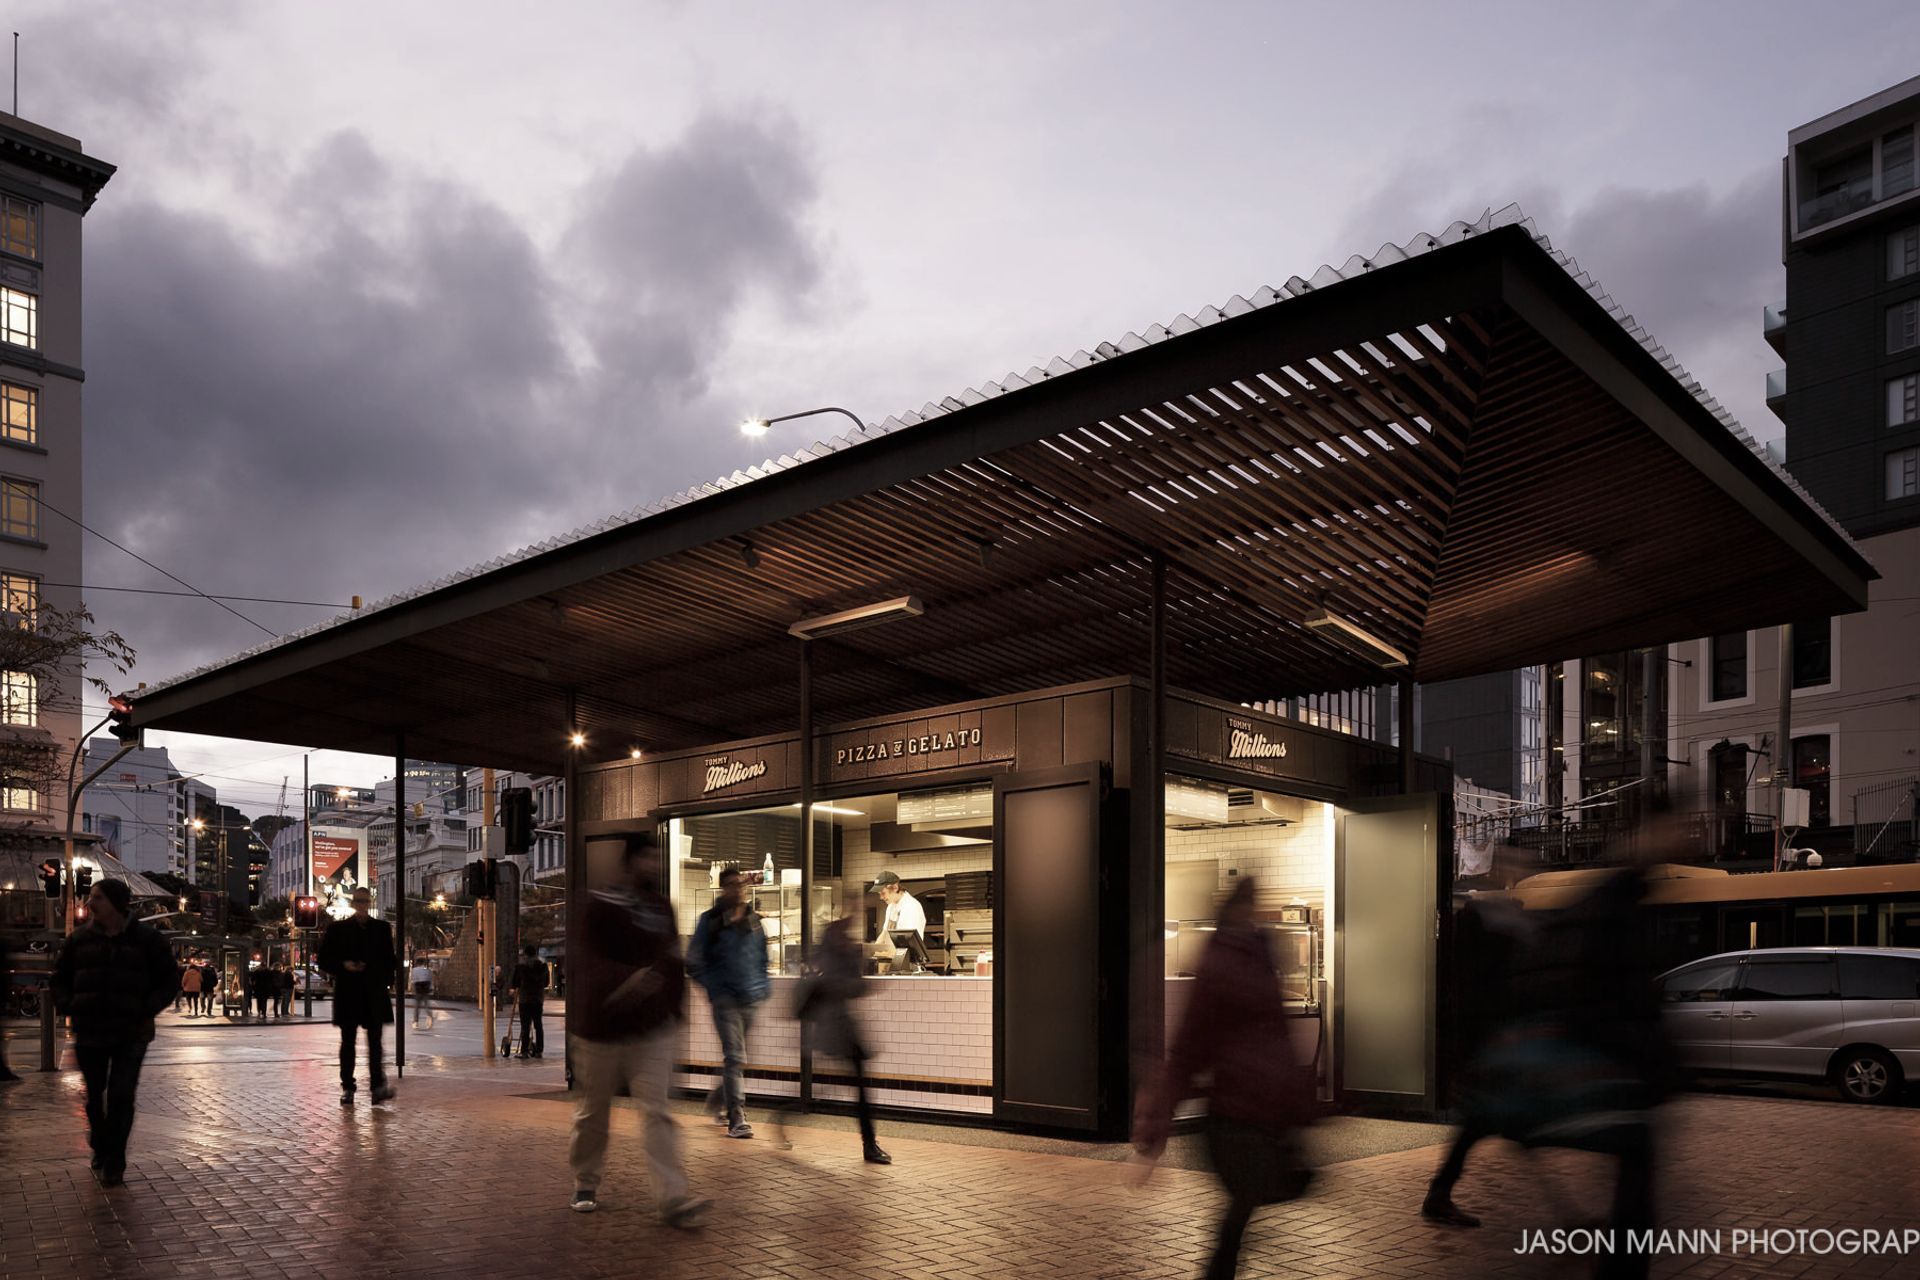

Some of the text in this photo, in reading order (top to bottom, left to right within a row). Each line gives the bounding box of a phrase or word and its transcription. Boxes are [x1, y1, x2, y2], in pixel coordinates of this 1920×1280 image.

[1229, 718, 1252, 731] TOMMY
[837, 744, 888, 764] PIZZA
[908, 728, 981, 754] GELATO
[1229, 729, 1287, 758] Millions
[704, 756, 728, 767] TOMMY
[703, 760, 766, 793] Millions
